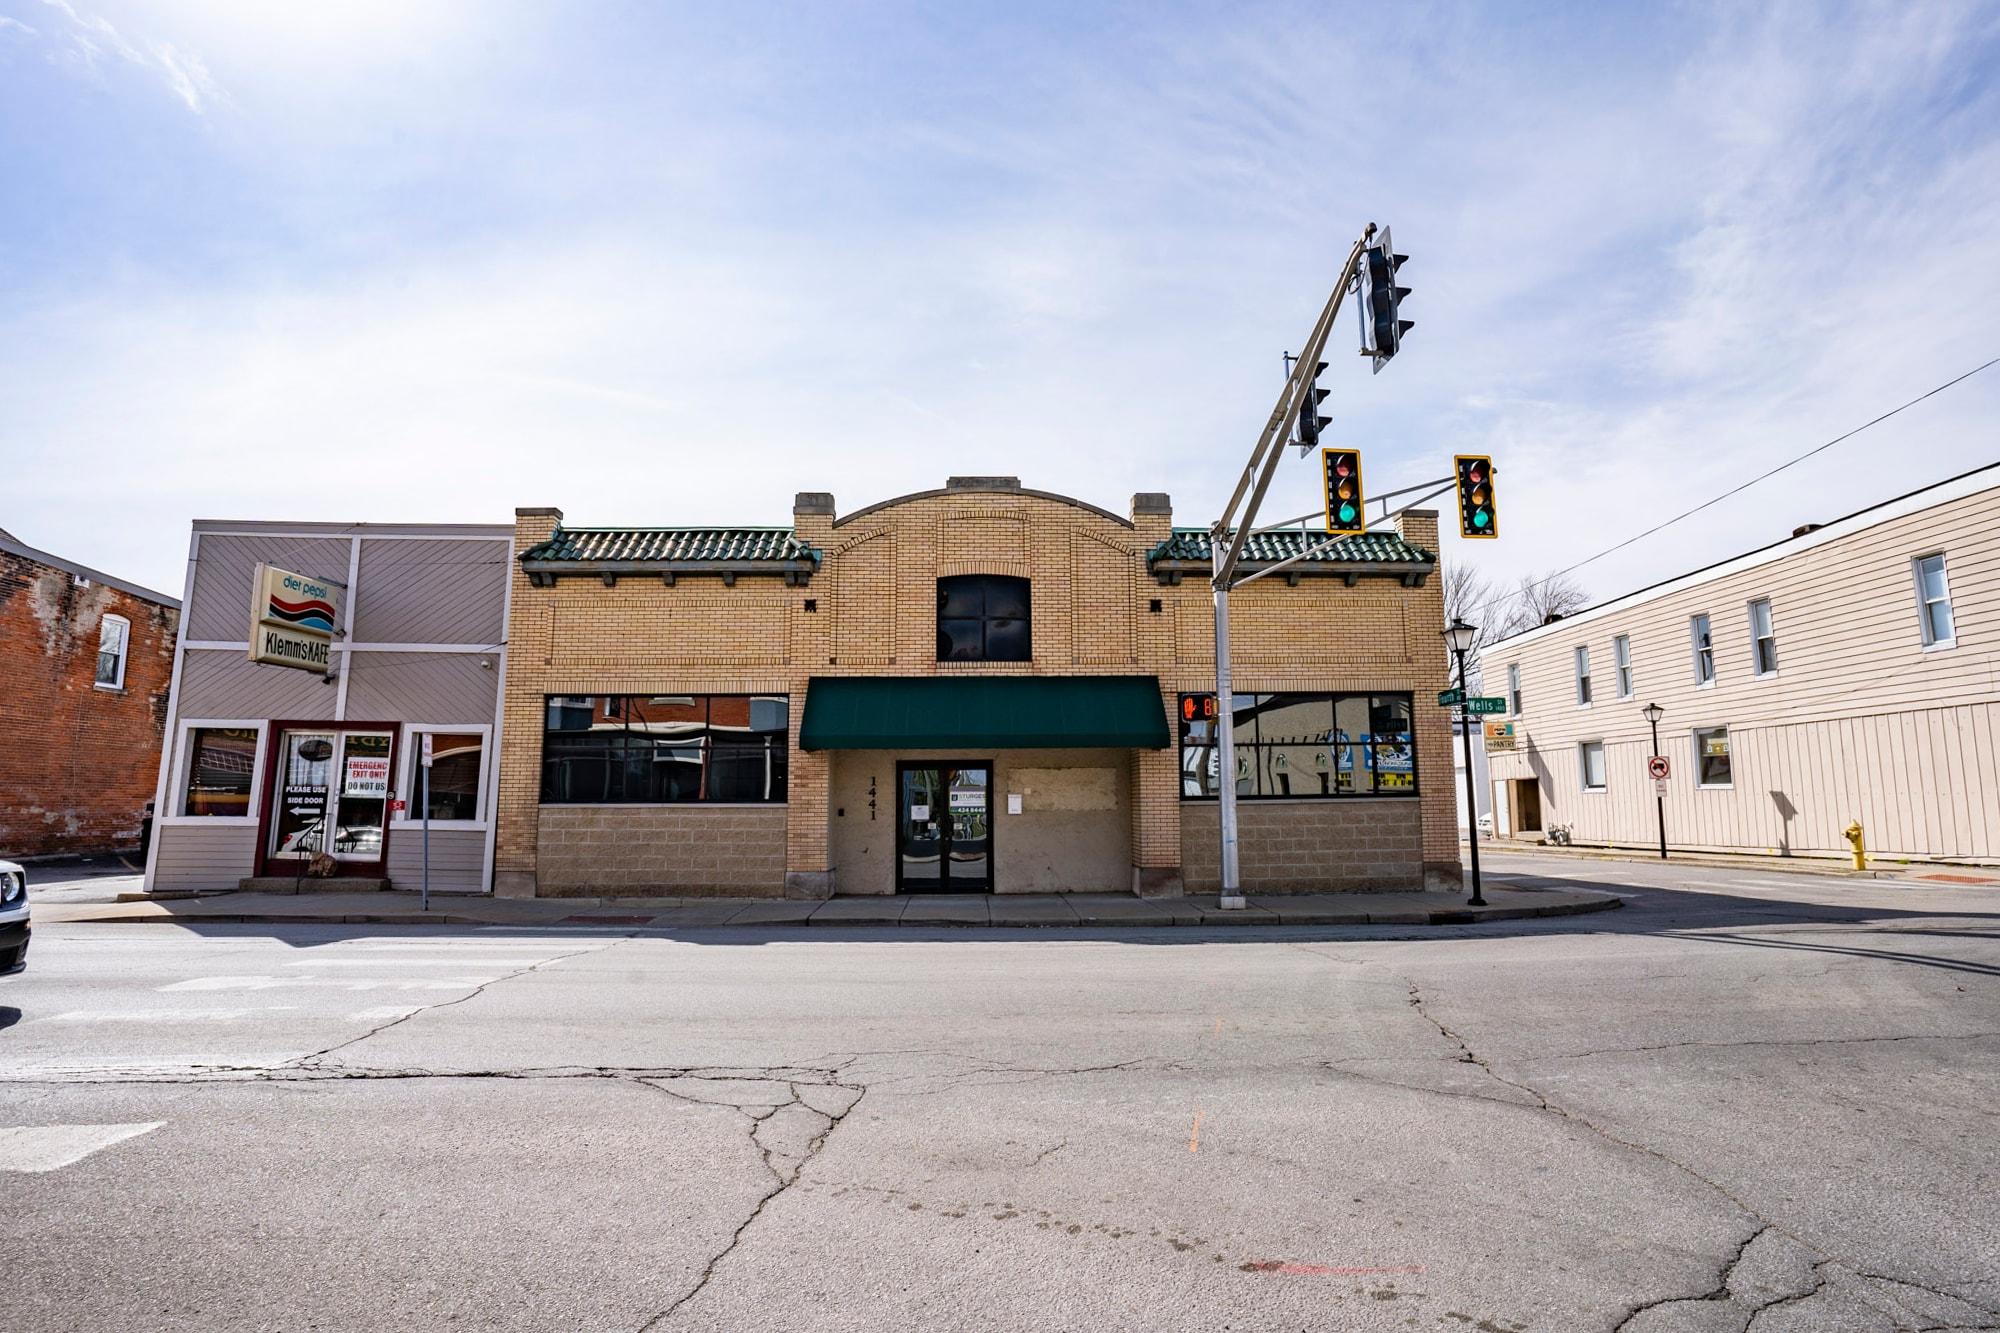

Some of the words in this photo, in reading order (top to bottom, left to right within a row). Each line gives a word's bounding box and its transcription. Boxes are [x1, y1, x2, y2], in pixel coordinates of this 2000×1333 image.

[283, 576, 301, 591] diet
[302, 583, 328, 600] pepsi
[265, 631, 308, 661] Klemm's
[307, 641, 330, 665] KAFE
[1204, 698, 1213, 716] 8
[1468, 700, 1494, 711] Wells
[1493, 739, 1515, 748] PANTRY
[349, 761, 389, 770] EMERGENC
[352, 770, 368, 779] EXIT
[369, 771, 387, 779] ONLY
[285, 785, 311, 793] PLEASE
[312, 786, 327, 794] USE
[348, 781, 358, 791] DO
[359, 782, 374, 791] NOT
[287, 796, 303, 804] SIDE
[303, 797, 324, 805] DOOR
[868, 776, 877, 821] 1441
